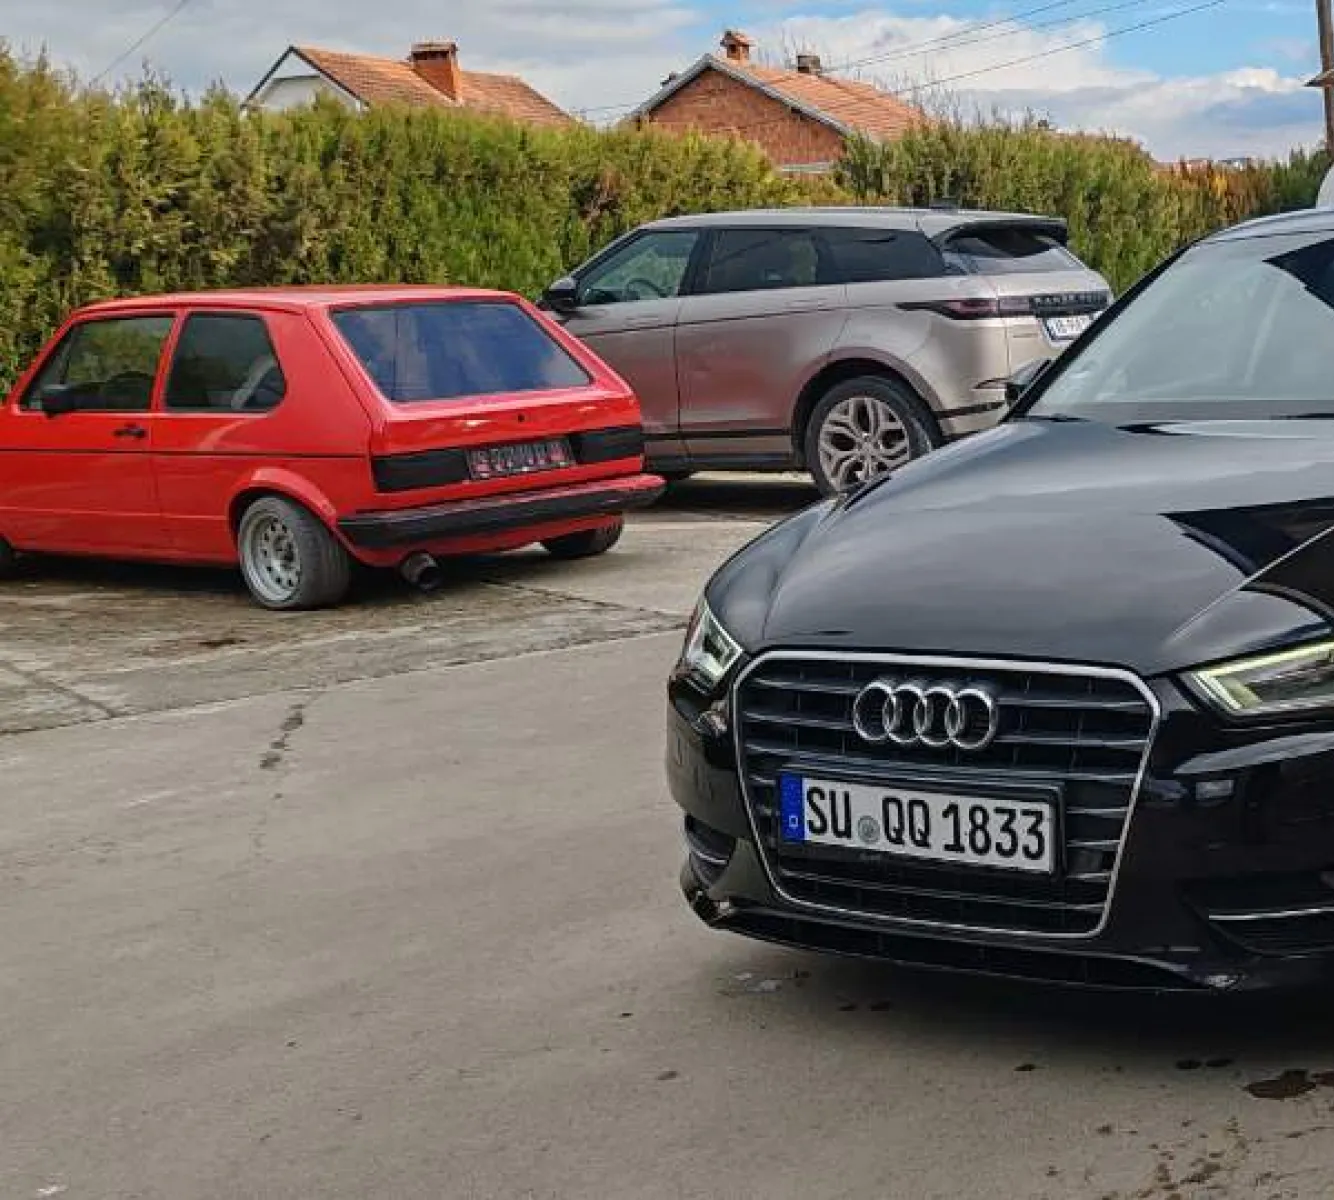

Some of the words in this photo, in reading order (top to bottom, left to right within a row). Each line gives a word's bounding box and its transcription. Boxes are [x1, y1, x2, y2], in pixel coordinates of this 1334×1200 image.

[806, 786, 851, 839] SU
[881, 796, 931, 849] QQ
[942, 802, 1046, 860] 1833
